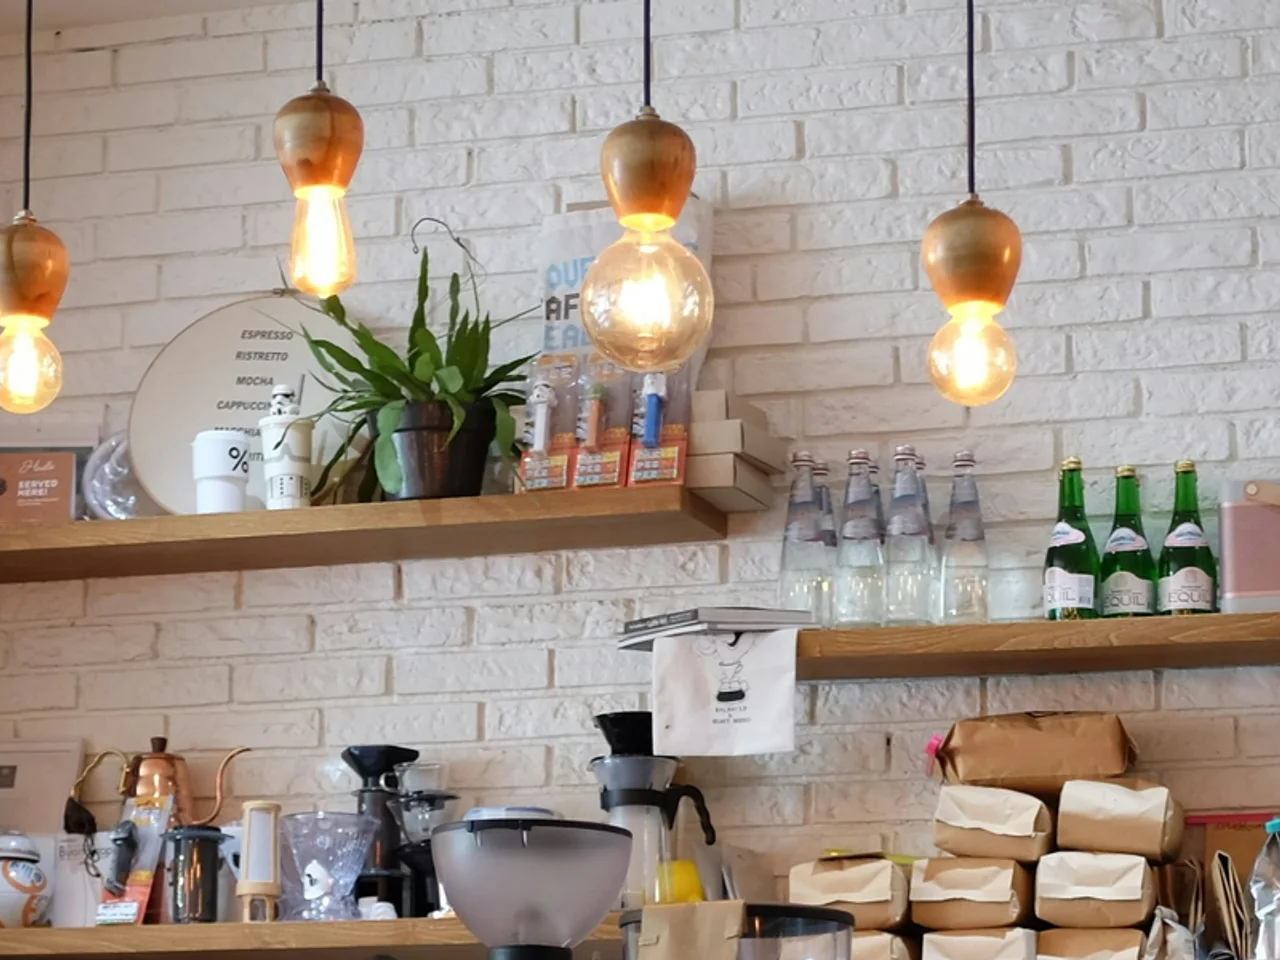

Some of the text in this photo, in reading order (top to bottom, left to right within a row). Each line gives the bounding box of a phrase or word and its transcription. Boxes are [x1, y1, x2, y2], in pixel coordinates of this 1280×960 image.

[240, 329, 293, 341] ESPRESSO
[235, 351, 289, 362] RISTRETTO
[235, 376, 274, 386] MOCHA
